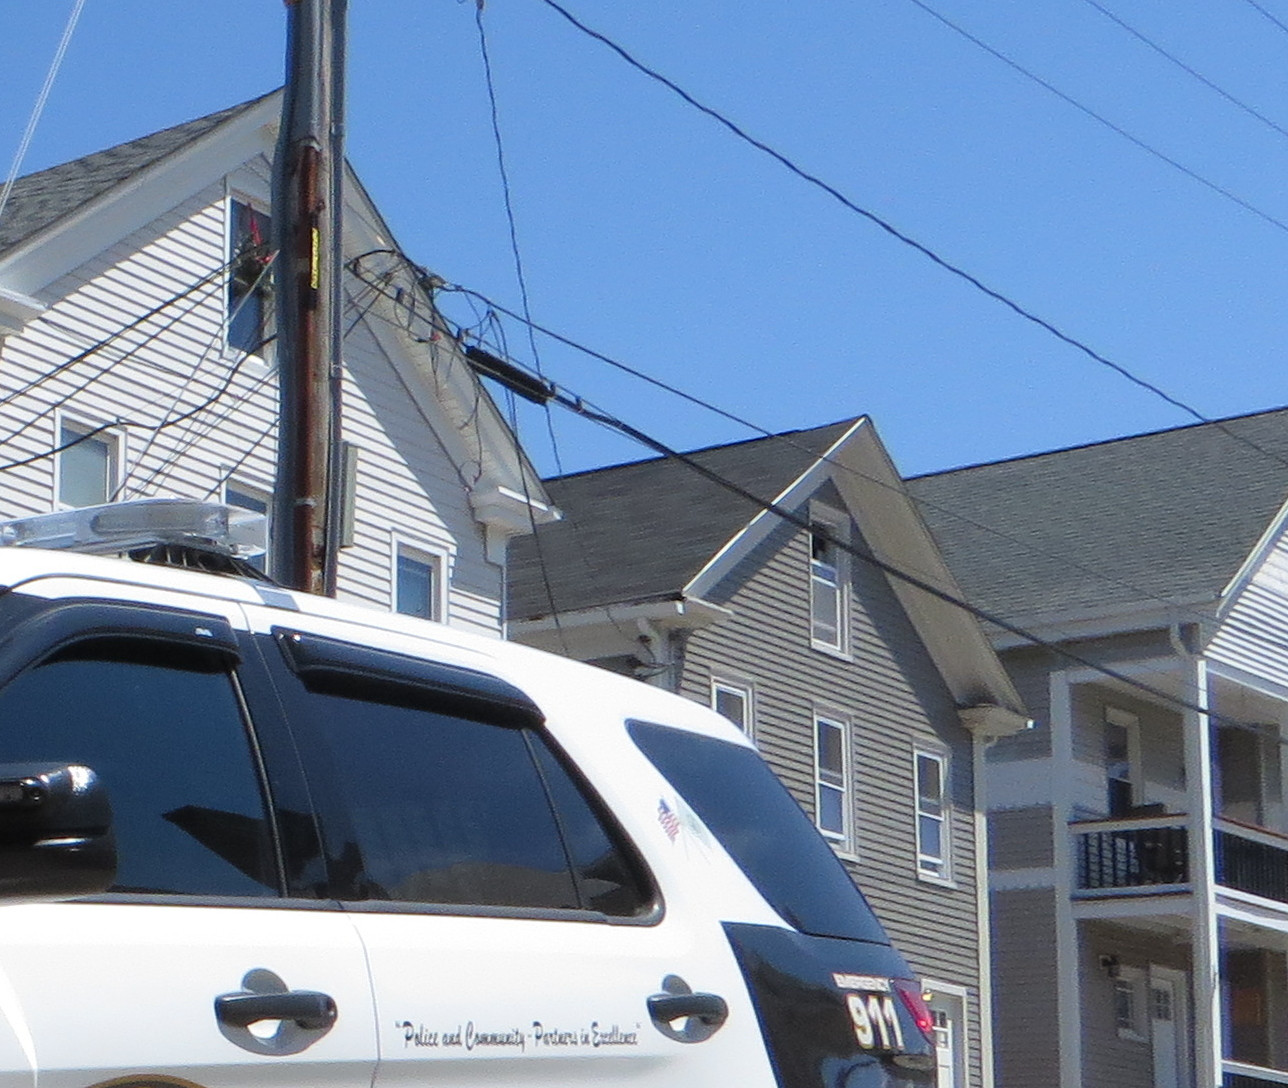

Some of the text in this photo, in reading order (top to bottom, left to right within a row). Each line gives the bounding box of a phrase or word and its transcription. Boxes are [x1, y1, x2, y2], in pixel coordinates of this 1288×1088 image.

[442, 1025, 462, 1046] and
[466, 1020, 526, 1052] Community
[580, 1028, 590, 1045] in
[845, 993, 905, 1050] 911
